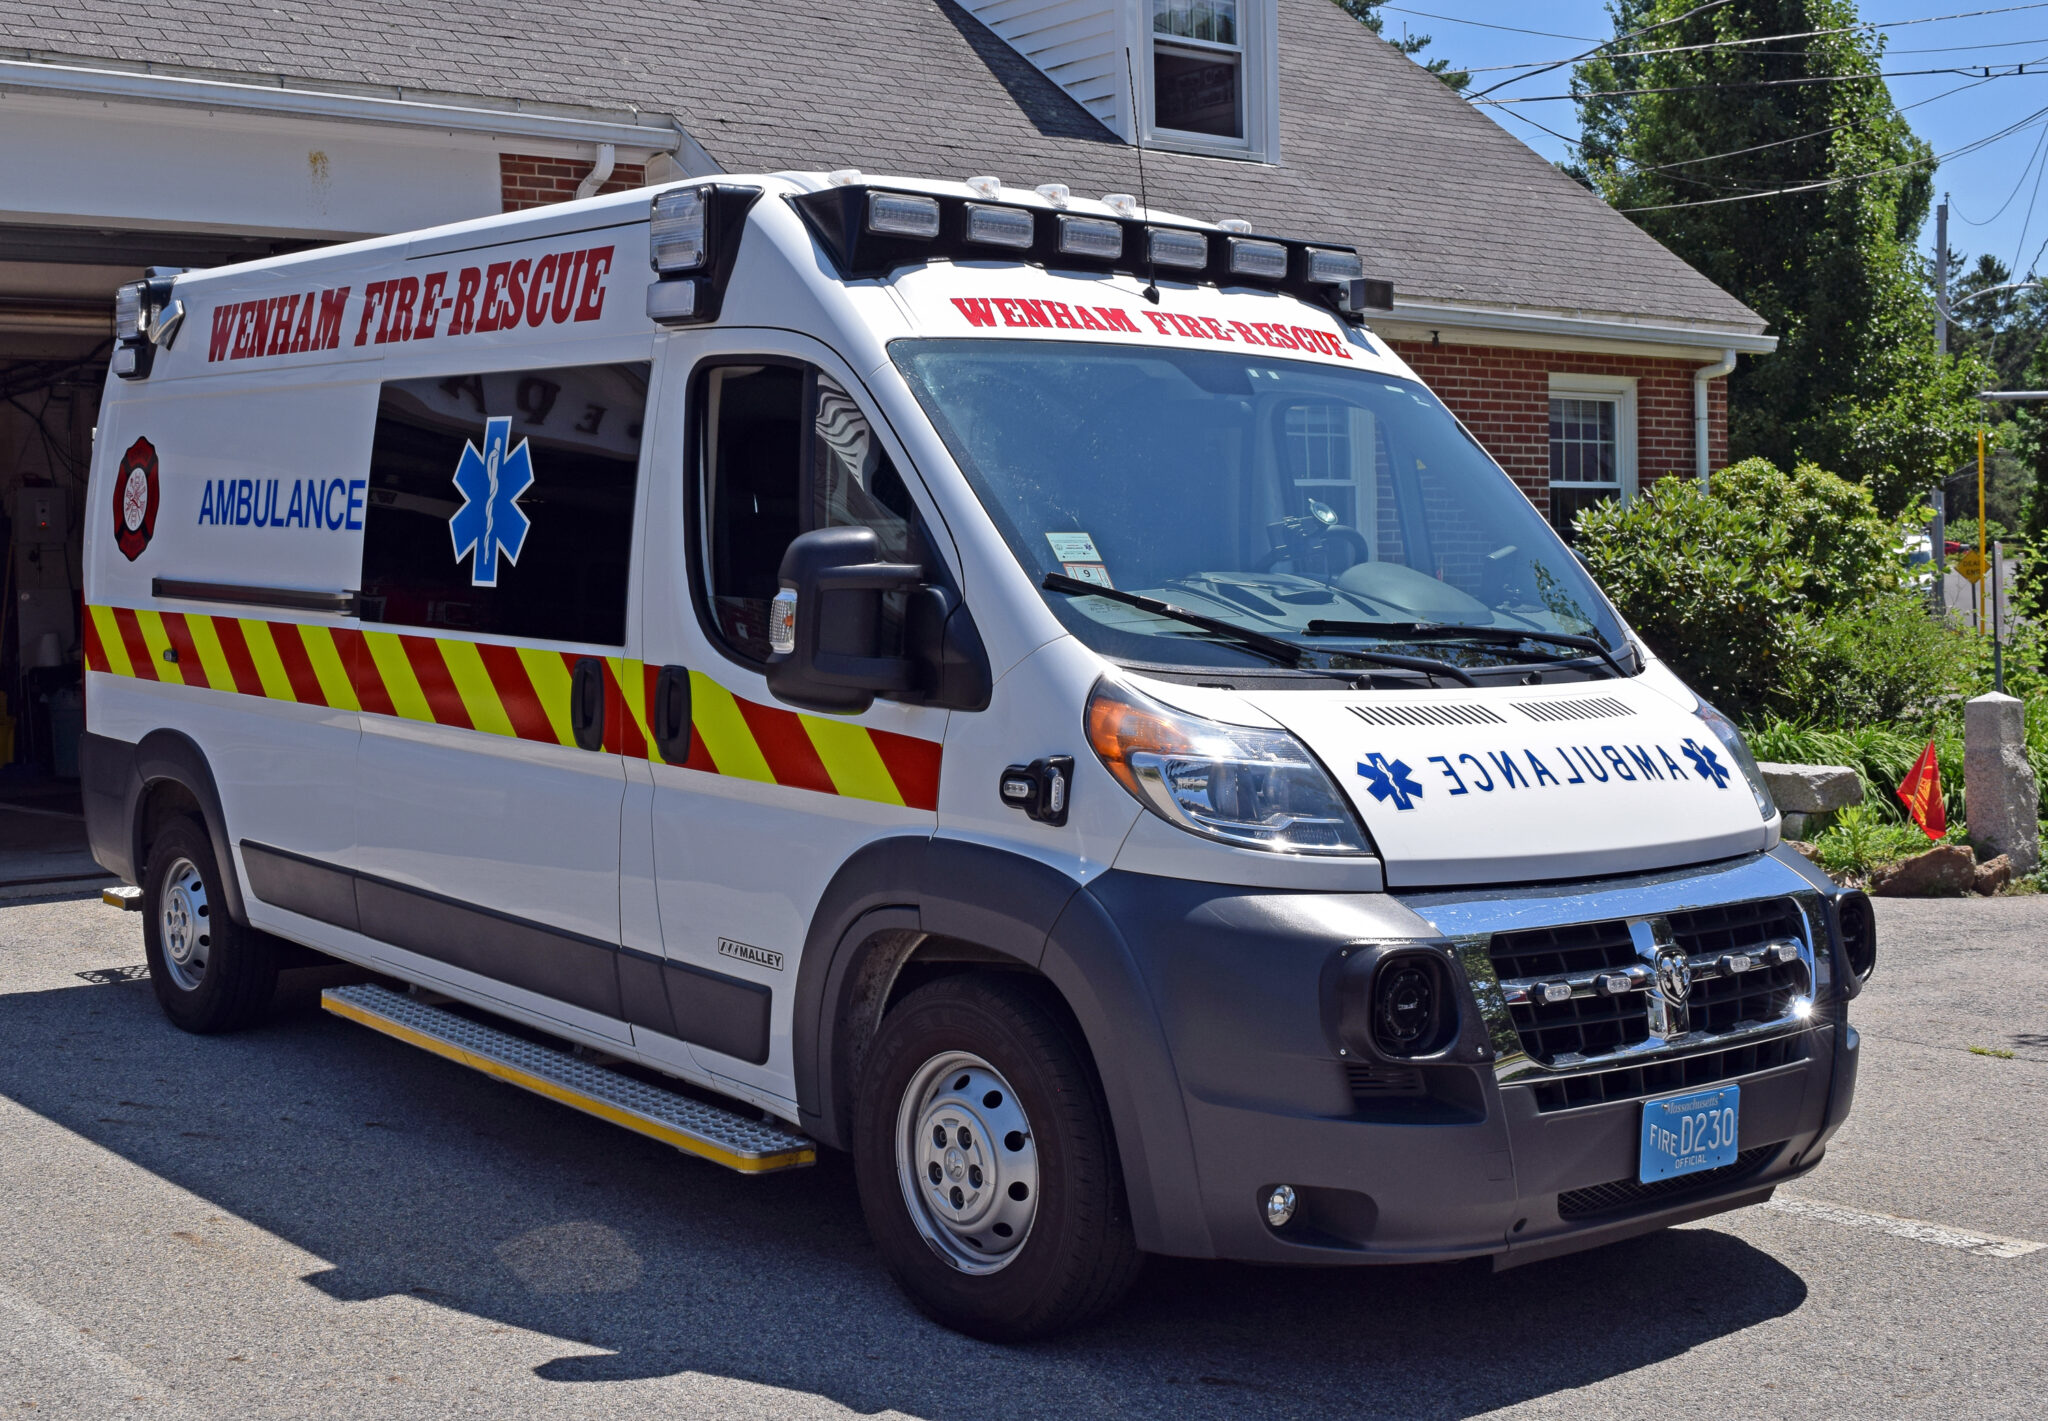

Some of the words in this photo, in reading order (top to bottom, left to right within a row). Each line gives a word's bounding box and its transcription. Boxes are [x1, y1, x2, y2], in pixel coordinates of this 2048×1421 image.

[208, 286, 351, 363] WENHAM
[354, 245, 615, 346] FIRE-RESCUE
[949, 298, 1142, 333] WENHAM
[1141, 310, 1353, 360] FIRE-RESCUE
[198, 478, 367, 532] AMBULANCE
[1083, 569, 1091, 577] 9
[740, 946, 781, 966] MALLEY
[1666, 1097, 1718, 1114] Massachusetts
[1650, 1124, 1678, 1157] FIRE
[1680, 1107, 1734, 1155] D230
[1675, 1154, 1708, 1169] OFFICIAL
